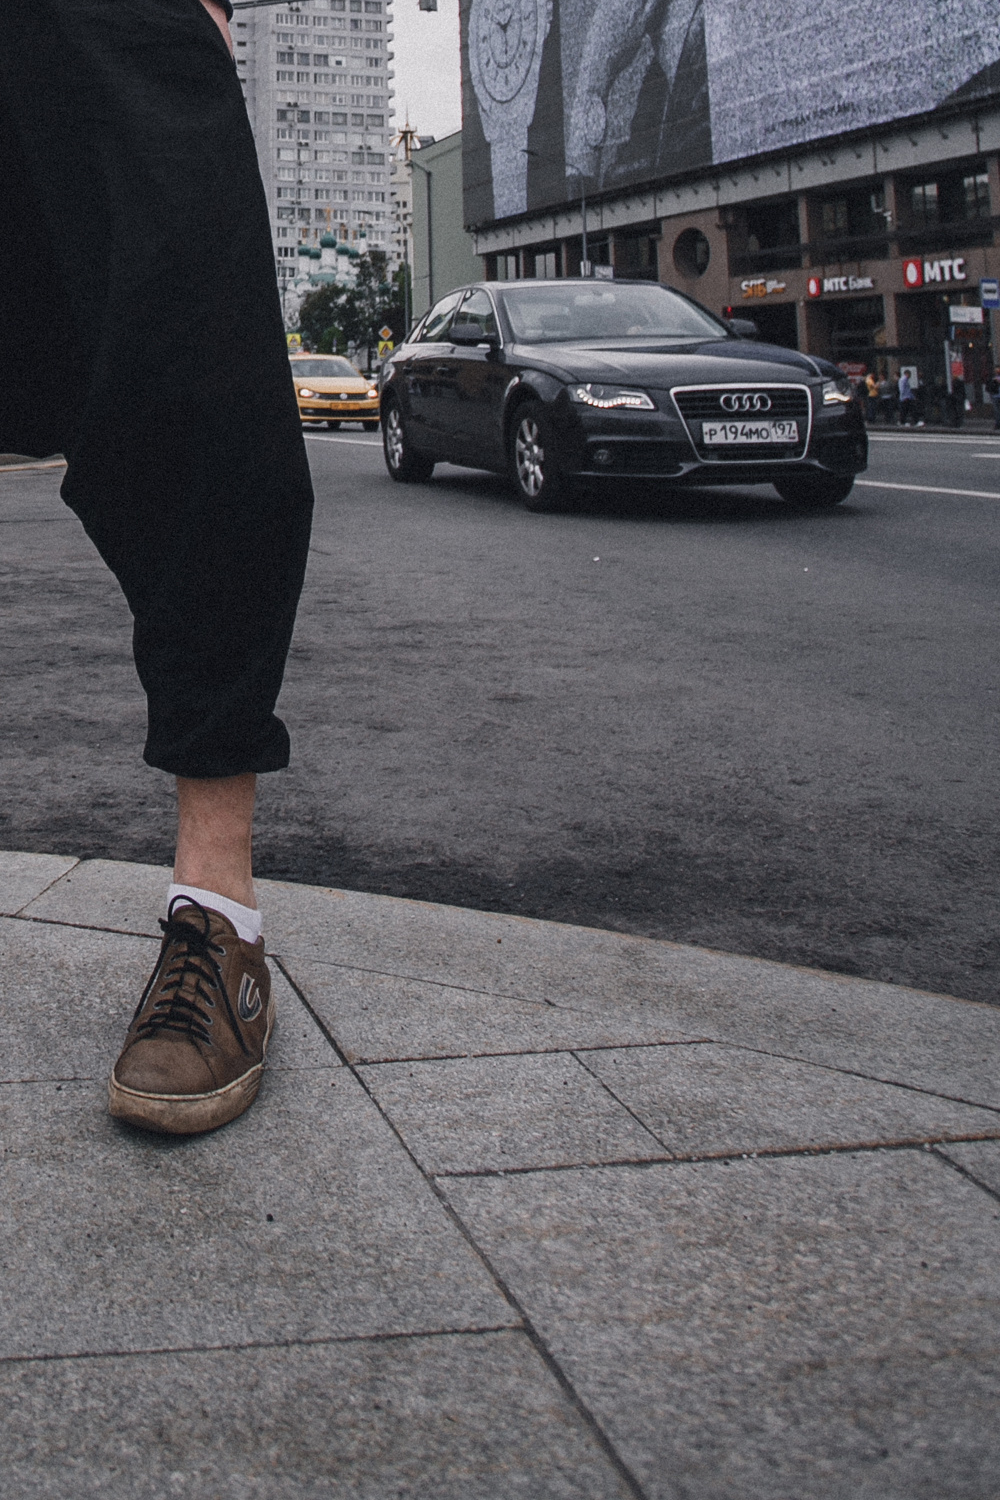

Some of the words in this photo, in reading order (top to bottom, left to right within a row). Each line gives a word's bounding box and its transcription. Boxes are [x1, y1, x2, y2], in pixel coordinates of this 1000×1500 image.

[924, 258, 966, 282] МТС
[823, 277, 847, 292] МТС
[772, 422, 793, 435] 197
